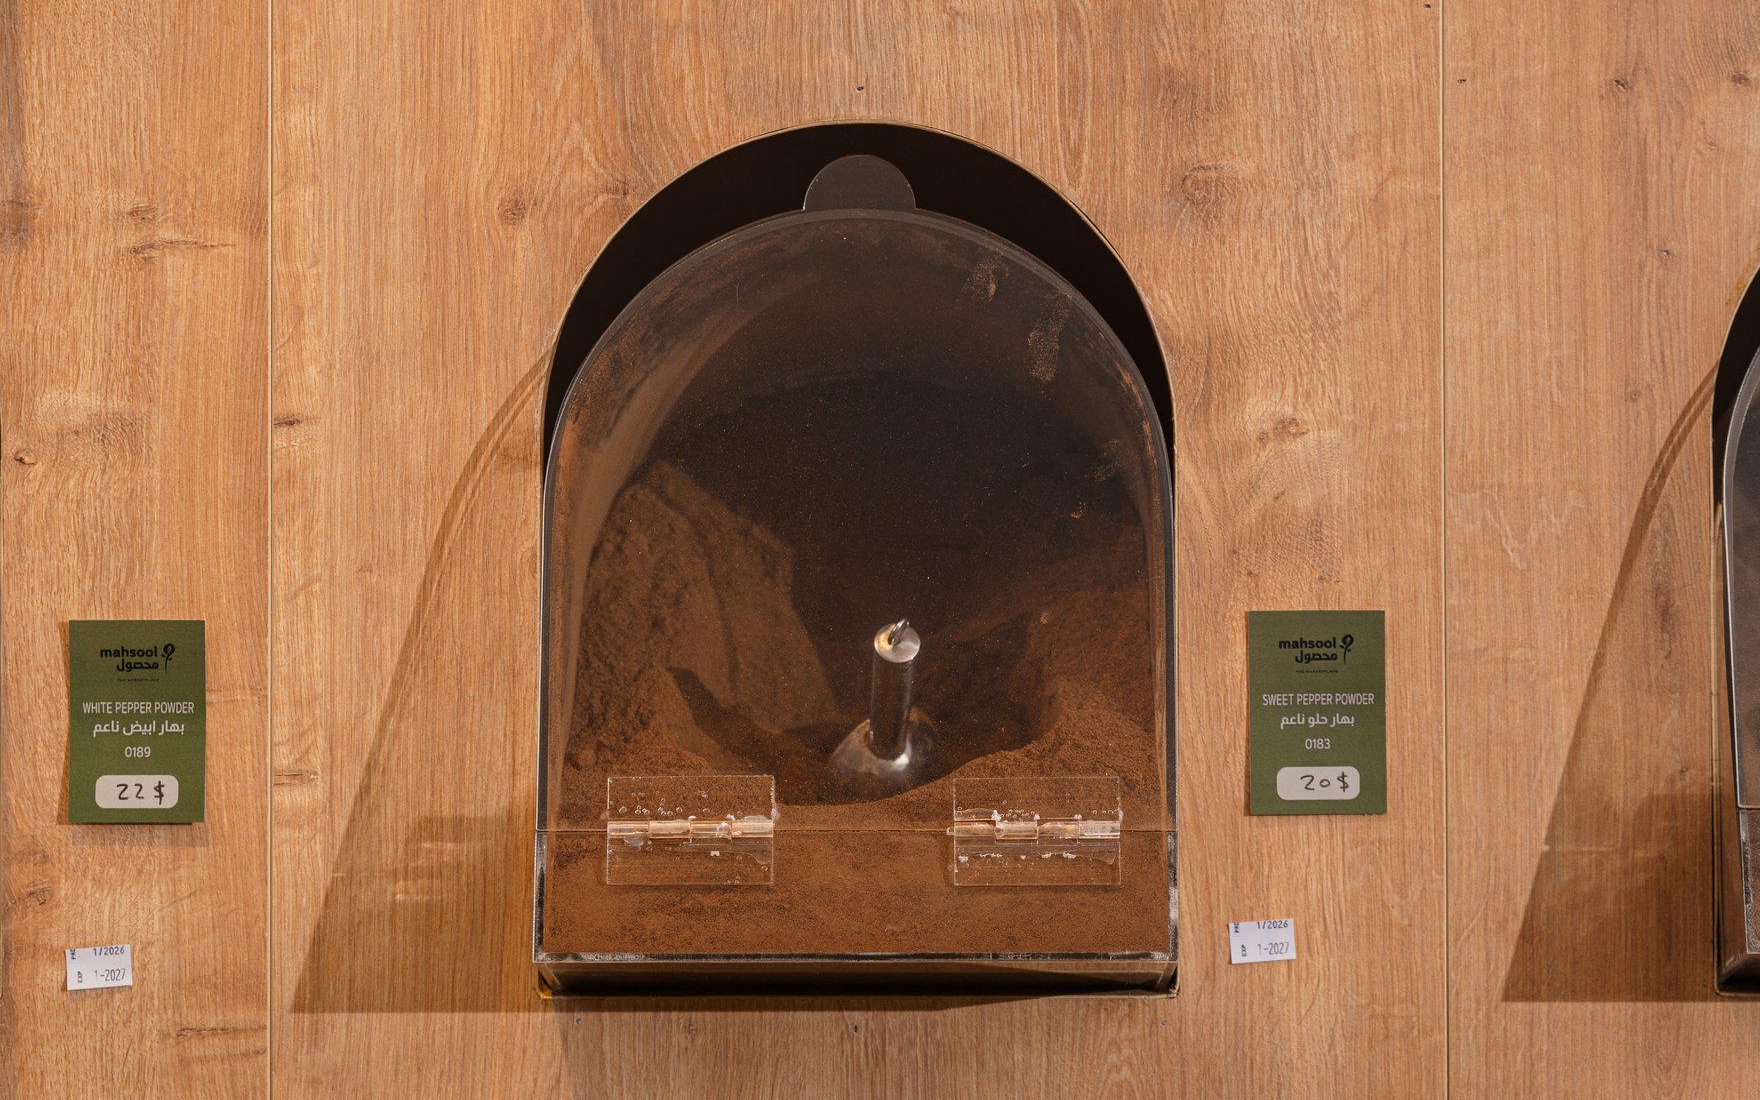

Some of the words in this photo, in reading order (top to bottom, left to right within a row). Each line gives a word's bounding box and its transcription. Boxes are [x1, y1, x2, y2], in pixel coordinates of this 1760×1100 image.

[1279, 637, 1337, 649] mahsool
[100, 646, 158, 658] mahsool
[1295, 650, 1338, 664] محصول
[116, 659, 159, 672] محصول
[1262, 694, 1294, 706] SWEET
[1297, 693, 1333, 705] PEPPER
[1335, 693, 1375, 705] POWDER
[82, 702, 113, 714] WHITE
[115, 702, 152, 714] PEPPER
[154, 701, 195, 714] POWDER
[1280, 713, 1305, 730] ناعم
[1308, 713, 1328, 728] حلو
[1329, 713, 1355, 728] بهار
[93, 720, 120, 738] ناعم
[122, 720, 156, 736] ابيض
[158, 720, 185, 736] بهار
[1305, 738, 1331, 750] 0183
[124, 746, 151, 758] 0189
[1257, 920, 1289, 930] 1/2026
[93, 946, 125, 956] 1/2026
[1258, 942, 1289, 956] 1-2027
[94, 968, 126, 982] 1-2027
